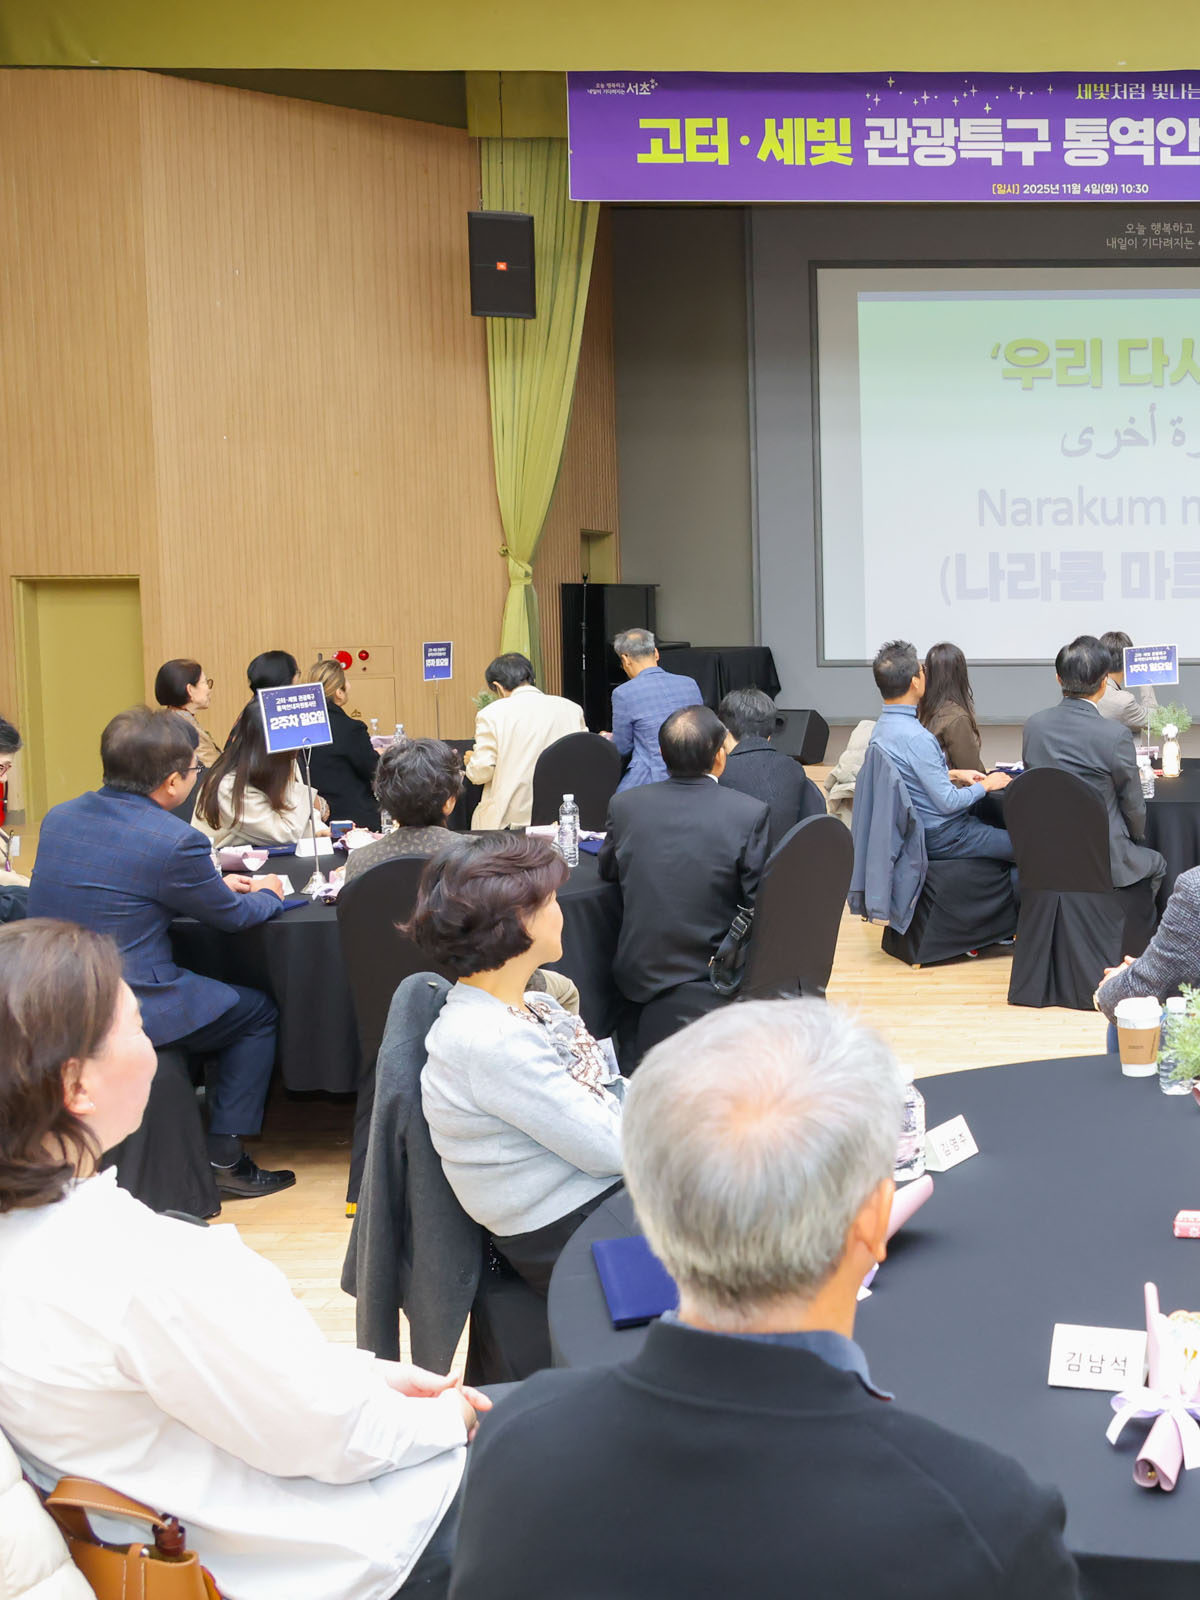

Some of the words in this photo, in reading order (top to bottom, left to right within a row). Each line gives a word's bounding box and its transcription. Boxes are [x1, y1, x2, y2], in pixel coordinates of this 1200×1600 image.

[626, 83, 651, 95] 서초
[1075, 82, 1145, 100] 세빛처럼
[864, 117, 1052, 166] 관광특구
[992, 183, 1020, 195] [일시]
[1023, 183, 1060, 195] 2025년
[1062, 183, 1081, 195] 11월
[1084, 183, 1118, 195] 4일(화)
[1121, 183, 1149, 194] 10:30
[1125, 223, 1147, 235] 오늘
[1150, 223, 1195, 235] 행복하고
[1106, 237, 1138, 250] 내일이
[1142, 237, 1195, 250] 기다려지는
[1060, 402, 1157, 459] أخرى
[977, 485, 1166, 527] Narakum
[270, 713, 300, 730] 2주차
[299, 710, 326, 726] 일요일
